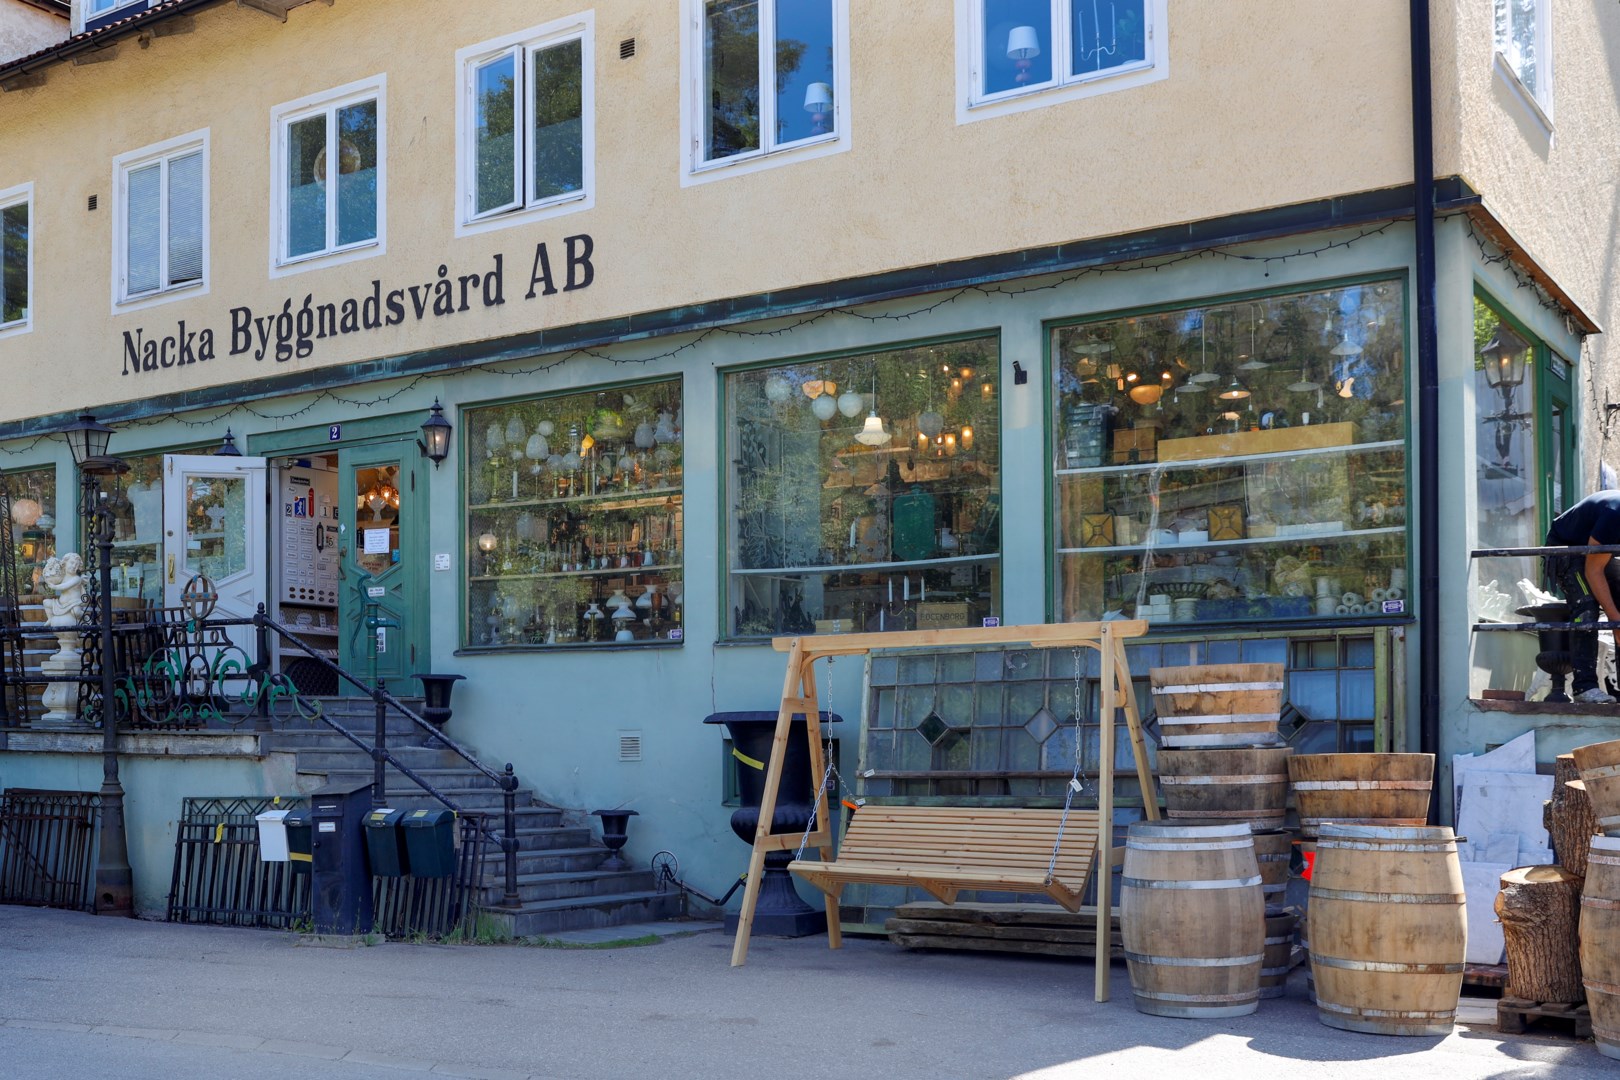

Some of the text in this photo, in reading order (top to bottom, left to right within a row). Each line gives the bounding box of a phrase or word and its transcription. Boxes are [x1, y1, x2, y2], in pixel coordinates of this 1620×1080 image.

[122, 234, 594, 375] Nacka Byggnadsvård AB
[332, 426, 338, 439] 2
